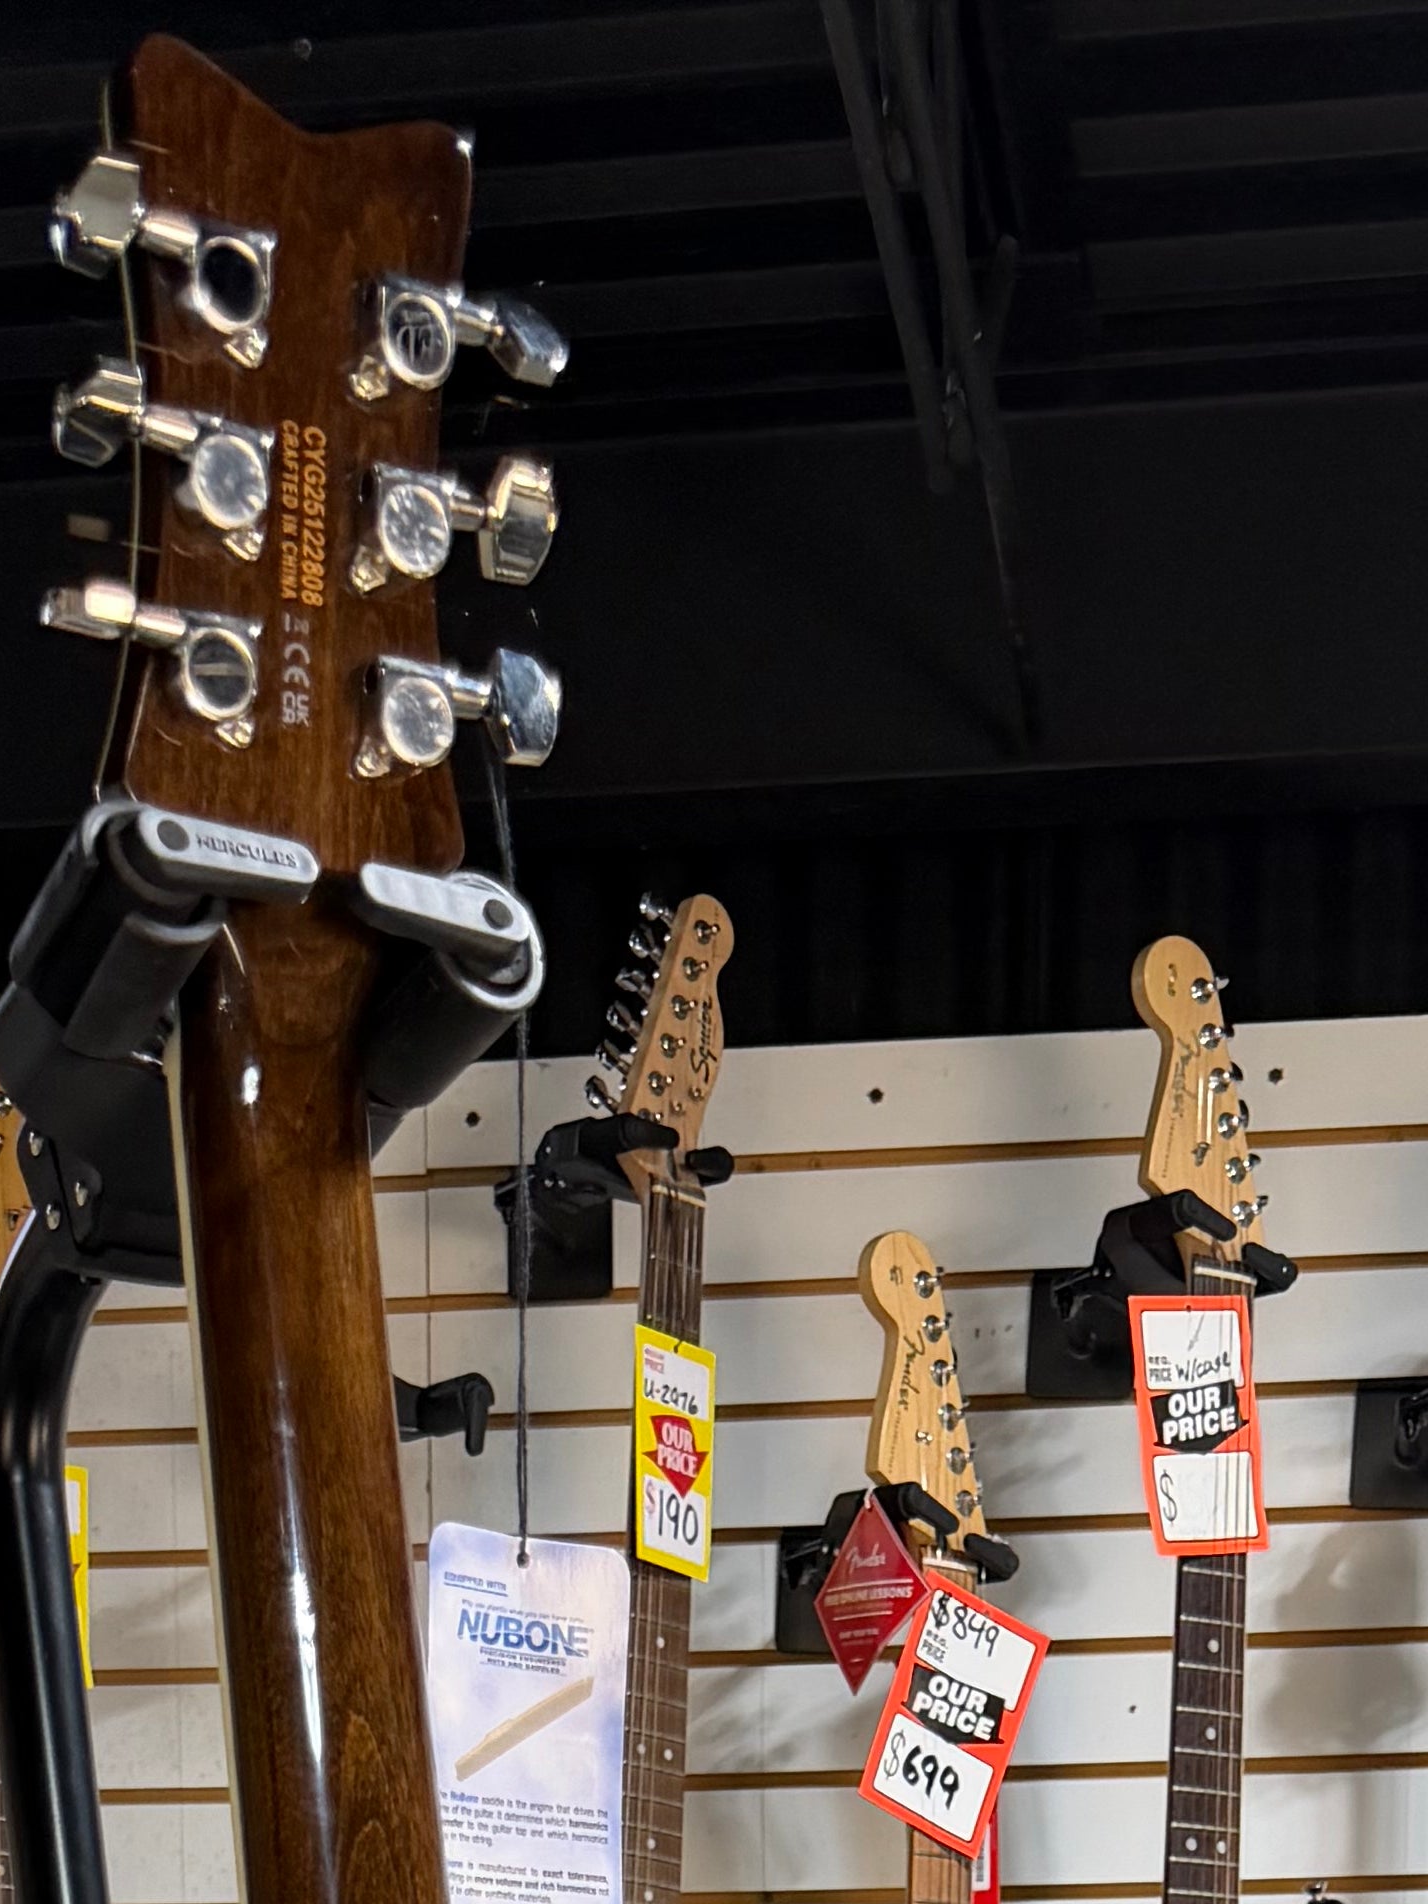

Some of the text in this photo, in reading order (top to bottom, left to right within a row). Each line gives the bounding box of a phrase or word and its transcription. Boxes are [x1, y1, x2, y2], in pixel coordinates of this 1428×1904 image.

[282, 419, 299, 599] CRAFTED IN CHINA
[301, 426, 327, 608] CYG25122808
[195, 831, 298, 869] HERCULES
[898, 1330, 927, 1413] Fender
[1162, 1406, 1237, 1446] PRICE
[1168, 1386, 1221, 1418] OUR
[656, 1443, 699, 1478] PRICE
[661, 1421, 694, 1454] OUR
[645, 1479, 699, 1546] $190
[1158, 1469, 1178, 1528] $
[457, 1607, 590, 1659] NUBONE
[930, 1592, 1000, 1658] $849
[911, 1691, 996, 1742] PRICE
[927, 1674, 988, 1715] OUR
[883, 1729, 960, 1811] $699
